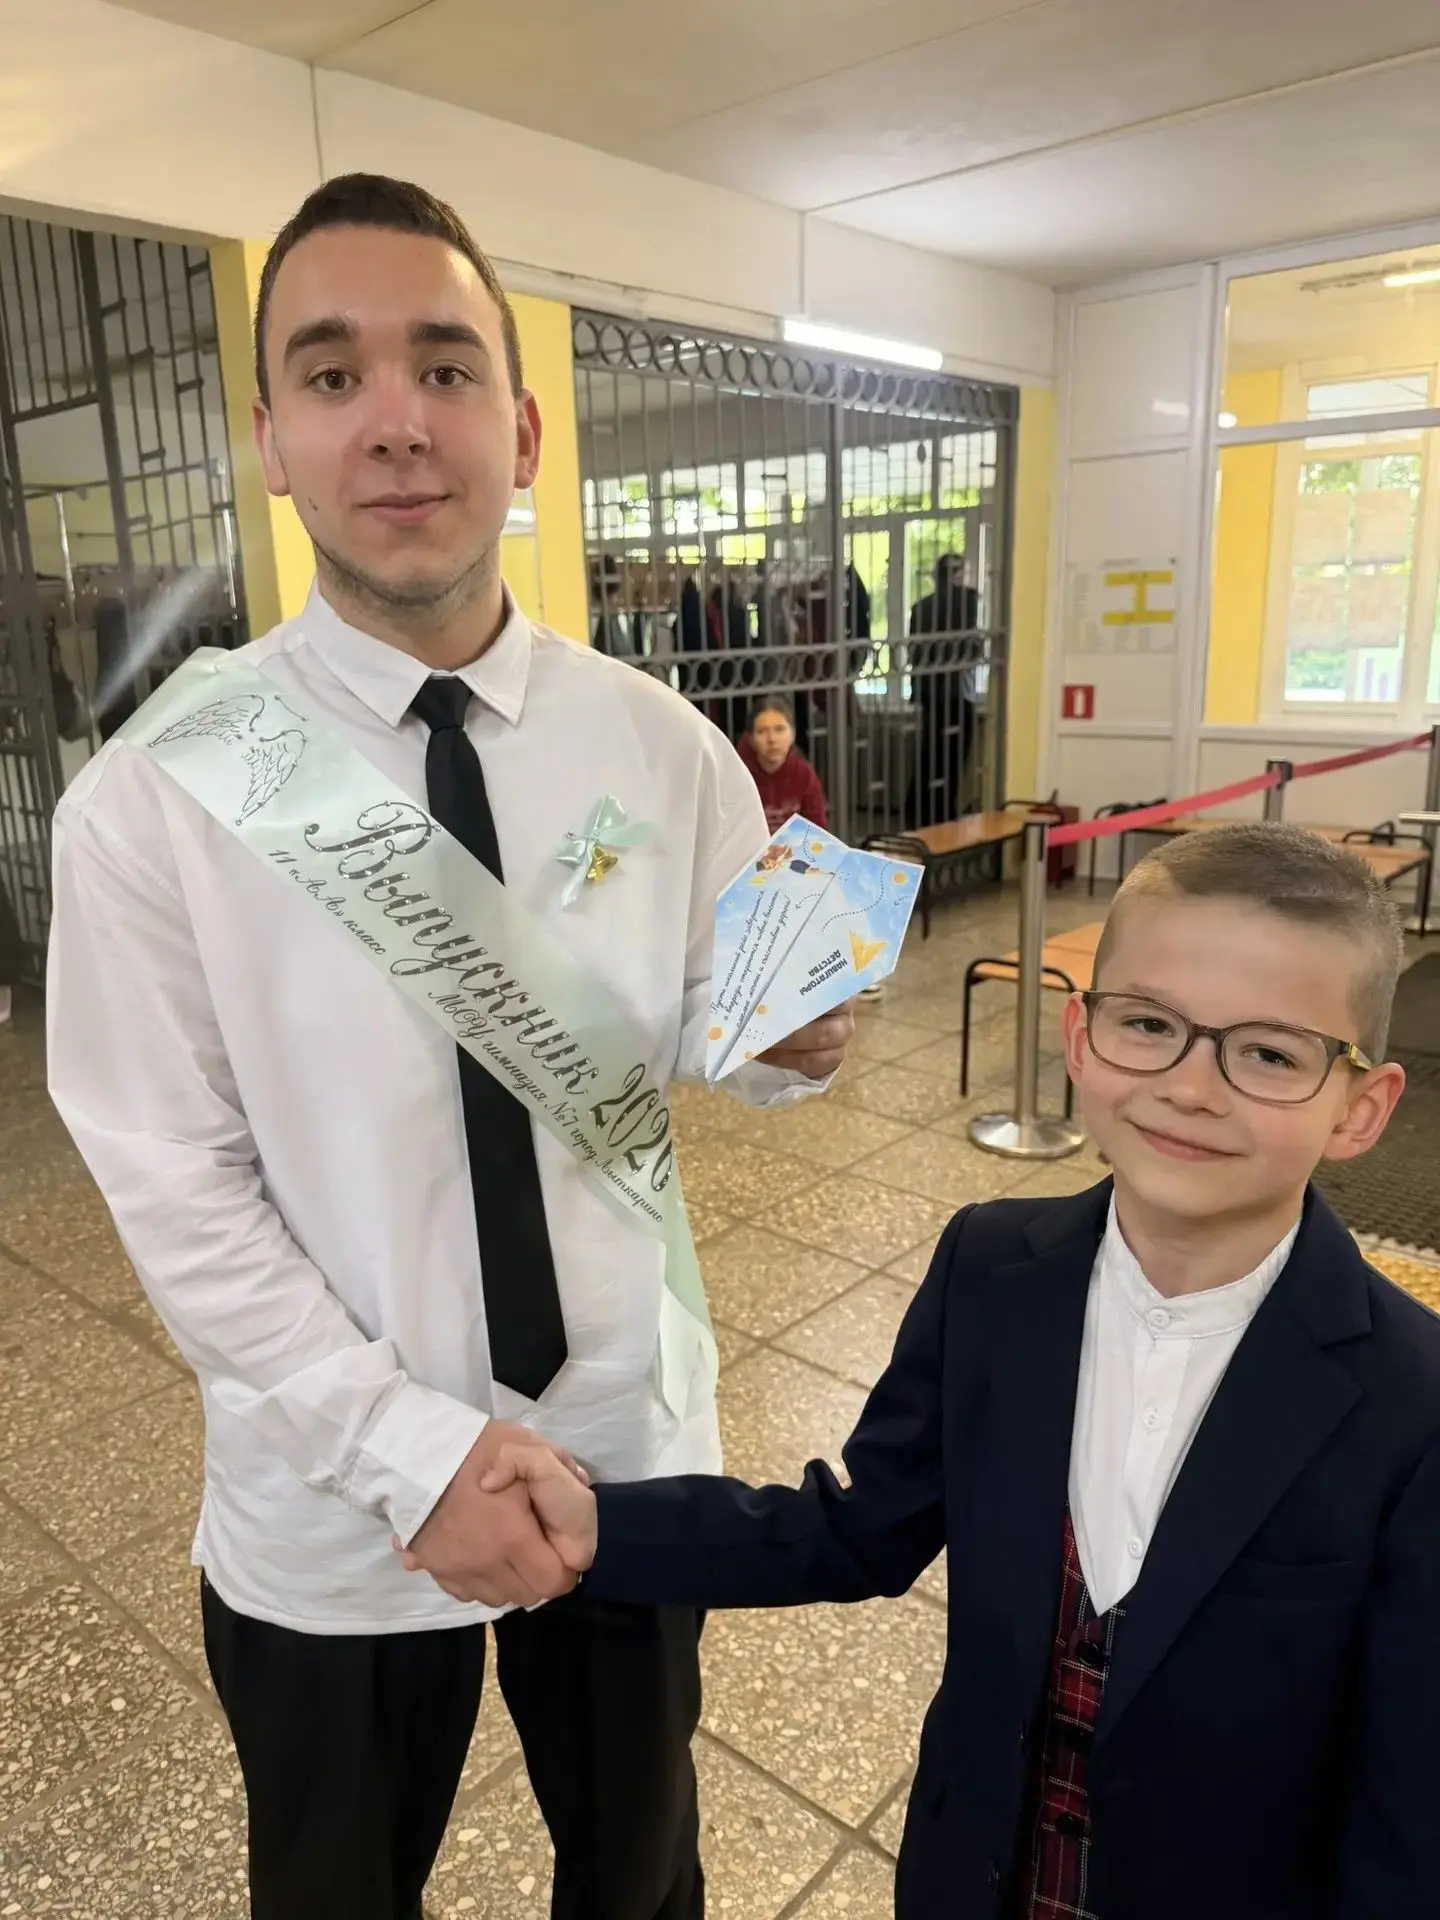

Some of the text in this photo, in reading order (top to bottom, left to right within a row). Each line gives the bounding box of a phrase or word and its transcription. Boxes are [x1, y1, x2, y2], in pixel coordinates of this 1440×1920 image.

[268, 850, 298, 863] 11
[343, 920, 386, 955] класс
[304, 801, 599, 1095] Выпускник
[808, 949, 841, 977] ДЕТСТВА
[799, 958, 848, 996] НАВИГАТОРЫ
[709, 989, 726, 1014] Пусть
[724, 985, 742, 1014] впереди
[428, 991, 496, 1040] МОУ
[482, 1040, 547, 1104] гимназия
[570, 1127, 597, 1161] город
[595, 1158, 664, 1223] Лыткарино
